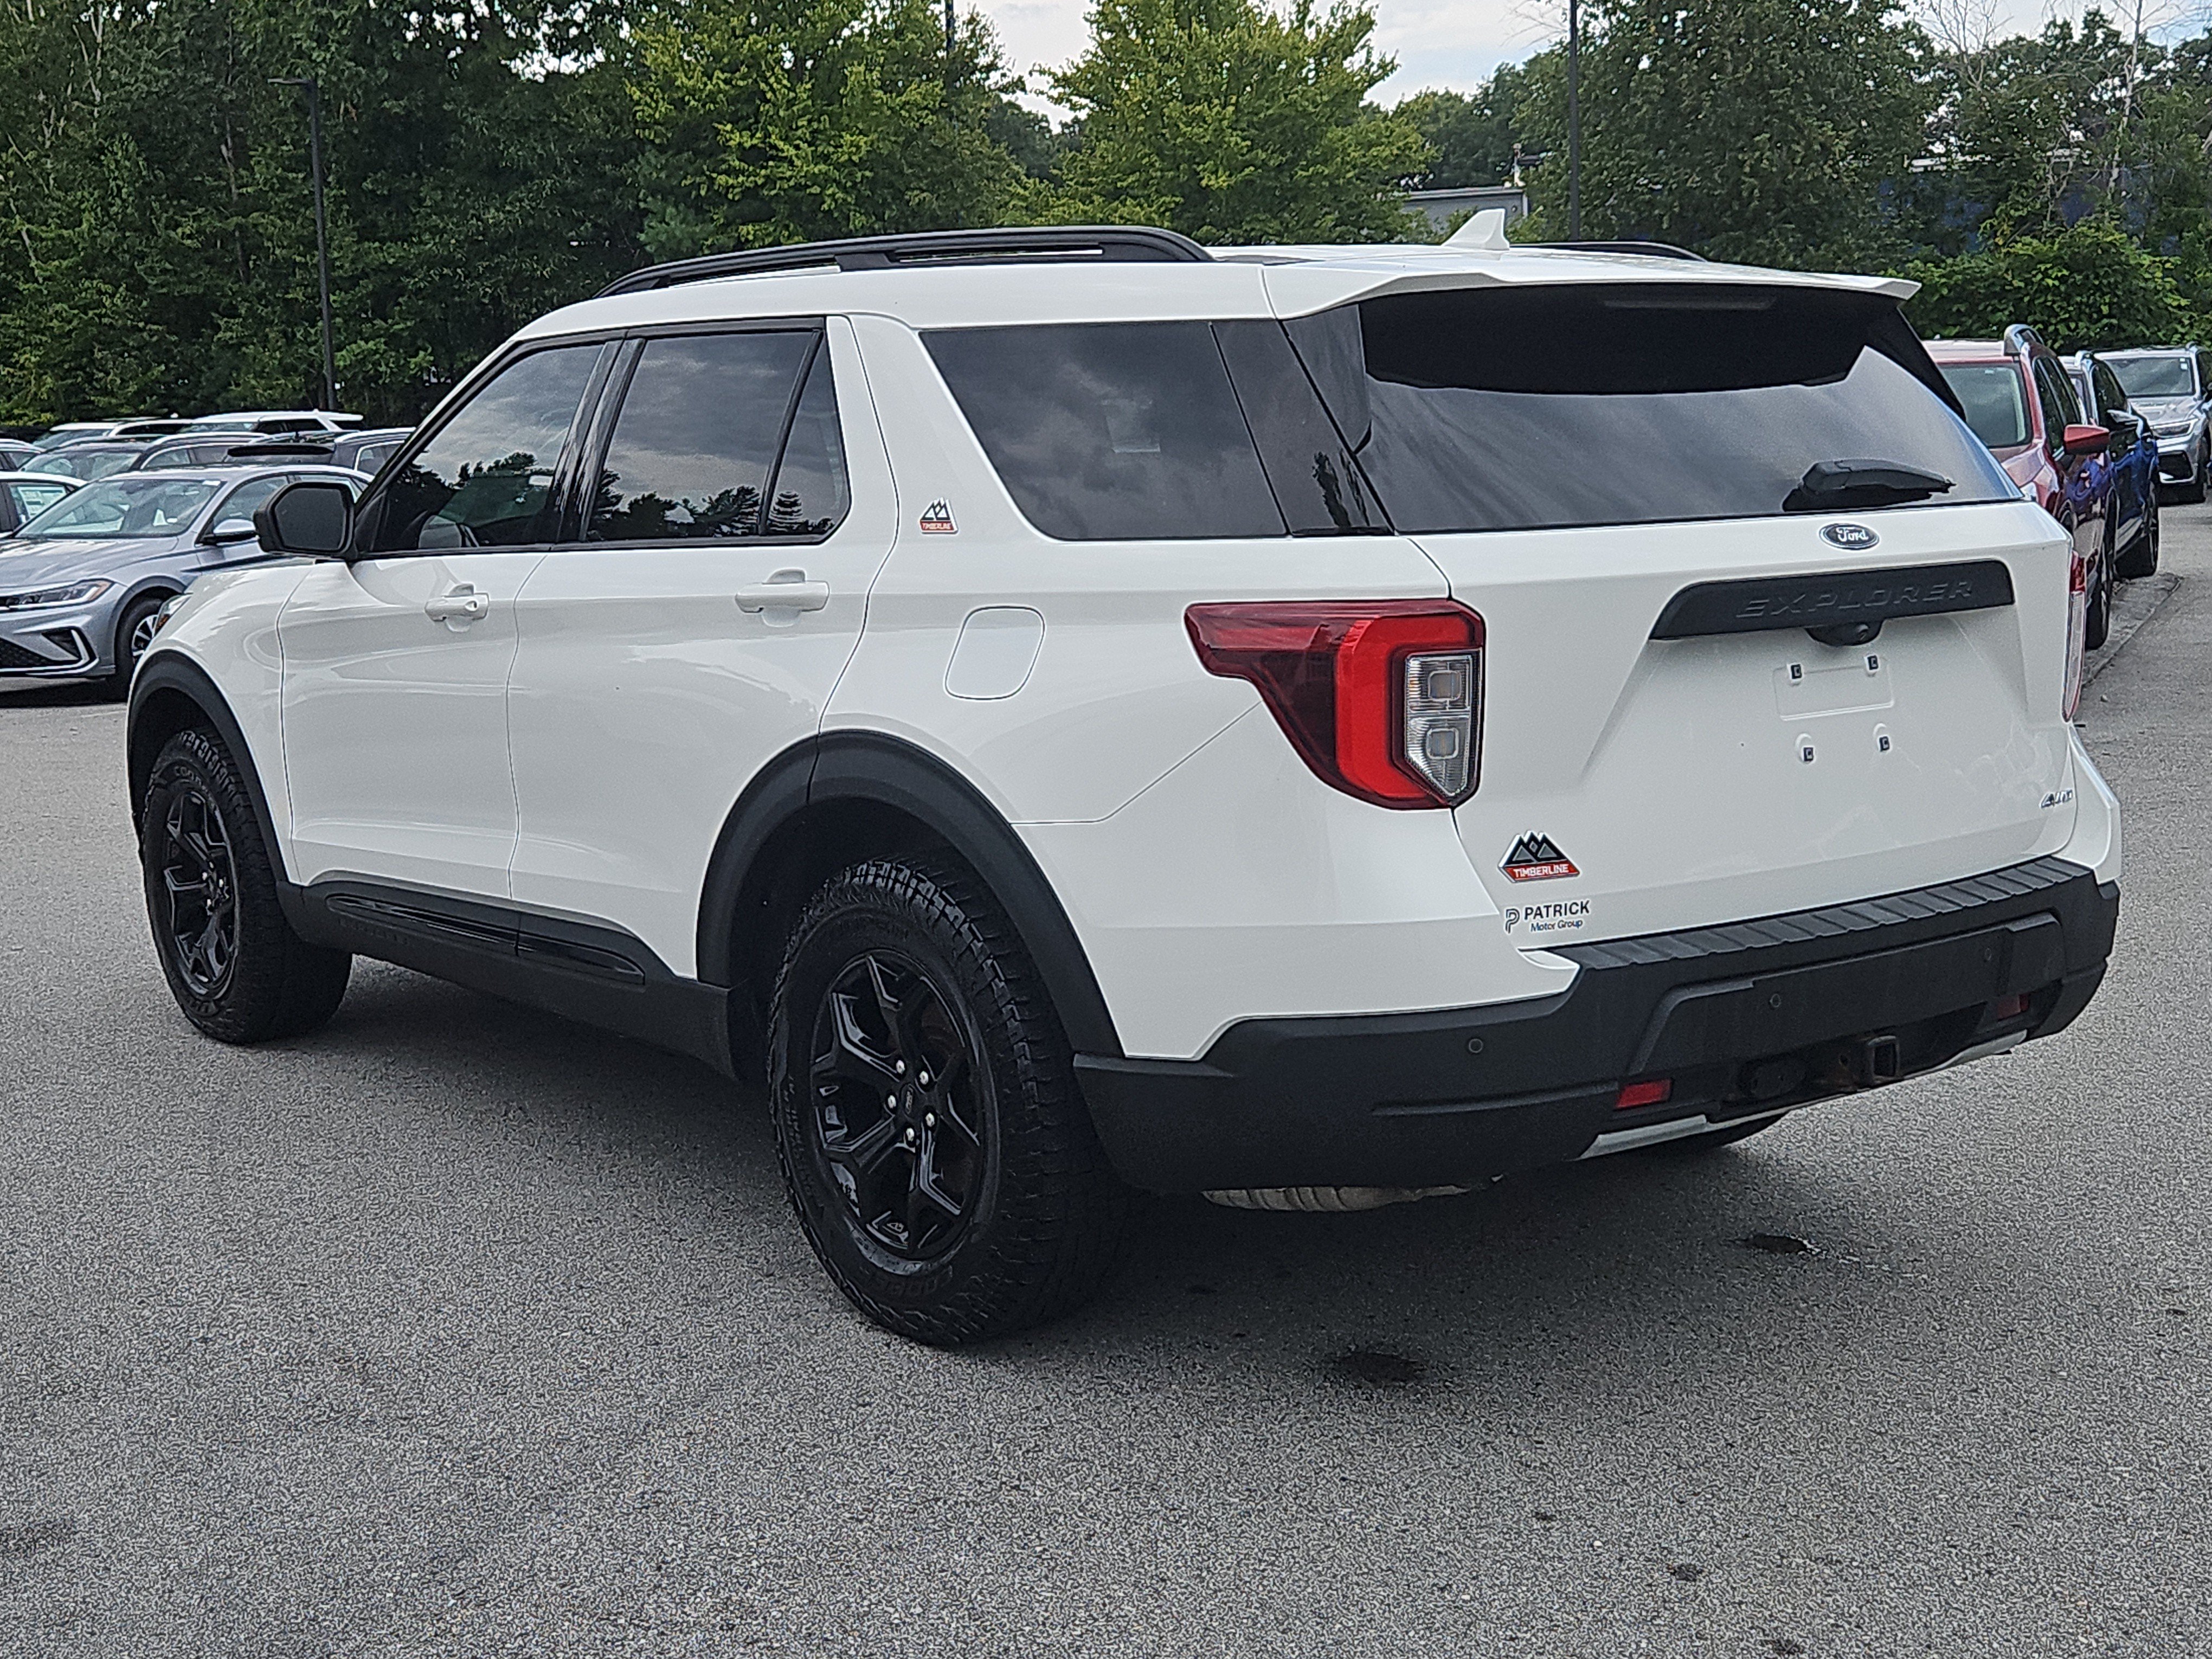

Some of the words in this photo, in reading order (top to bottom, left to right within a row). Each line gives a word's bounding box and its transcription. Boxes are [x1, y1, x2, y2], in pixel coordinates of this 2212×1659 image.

[1836, 526, 1869, 542] Ford
[1736, 582, 1972, 618] EXPLORER
[1513, 864, 1570, 878] TIMBERLINE
[1524, 900, 1590, 921] PATRICK
[1531, 922, 1555, 932] Motor
[1557, 920, 1583, 929] Group
